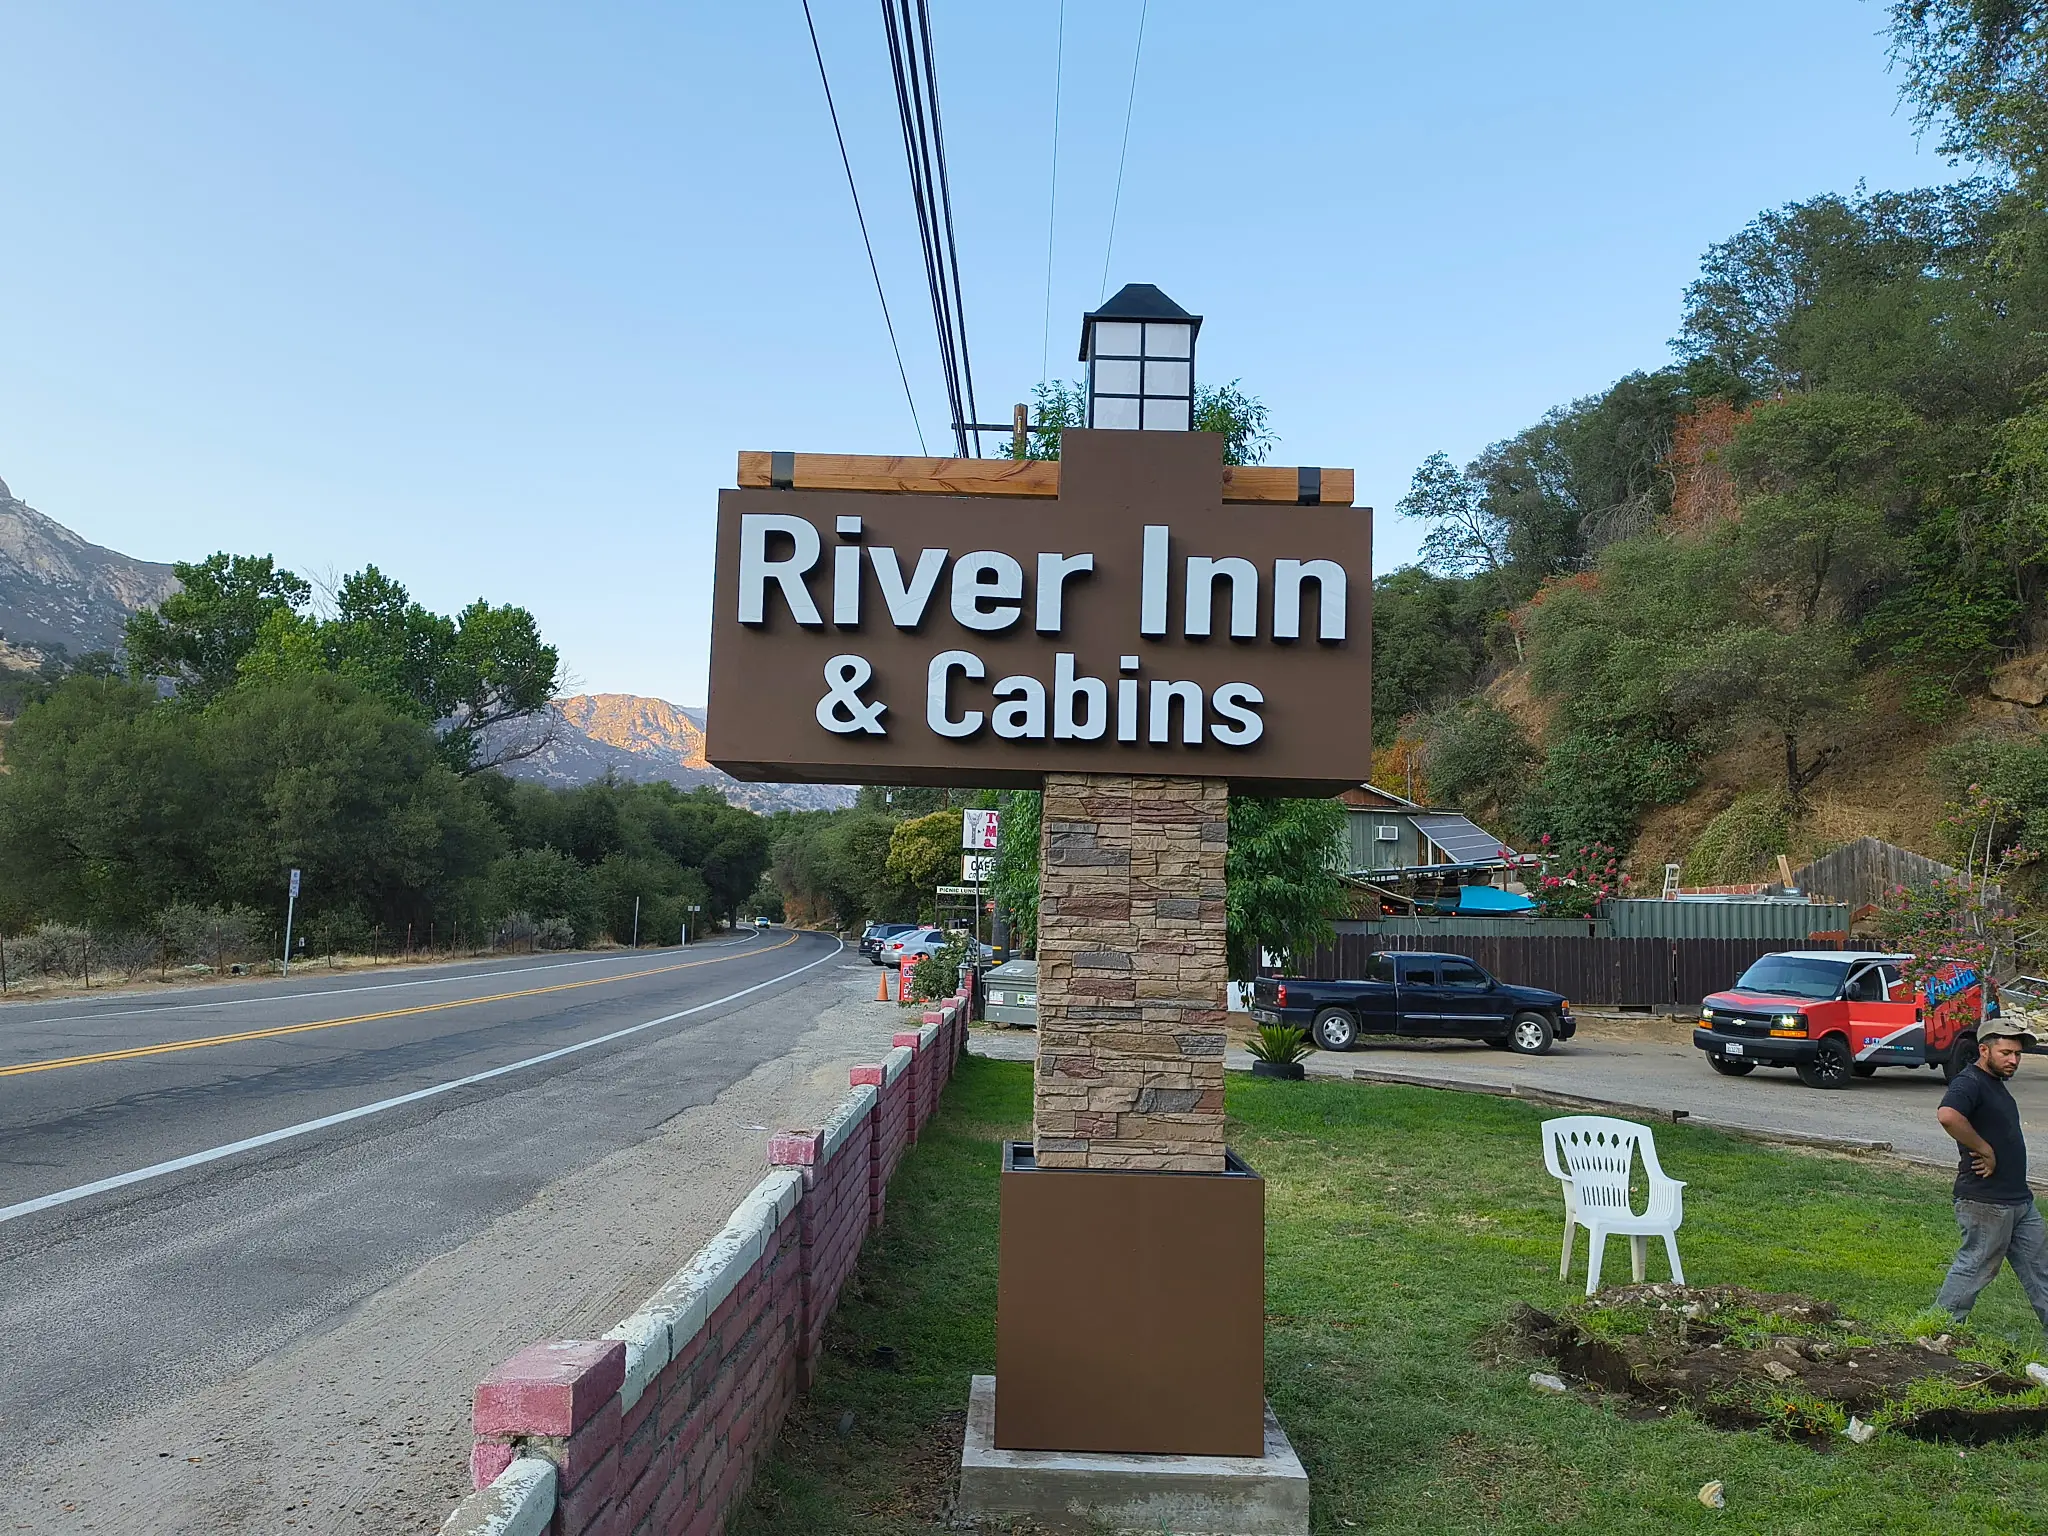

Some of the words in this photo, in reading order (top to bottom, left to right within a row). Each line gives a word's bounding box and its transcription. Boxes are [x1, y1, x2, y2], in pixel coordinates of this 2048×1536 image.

[738, 513, 1094, 632] River
[1141, 525, 1348, 641] Inn
[815, 654, 888, 735] &
[926, 650, 1264, 747] Cabins
